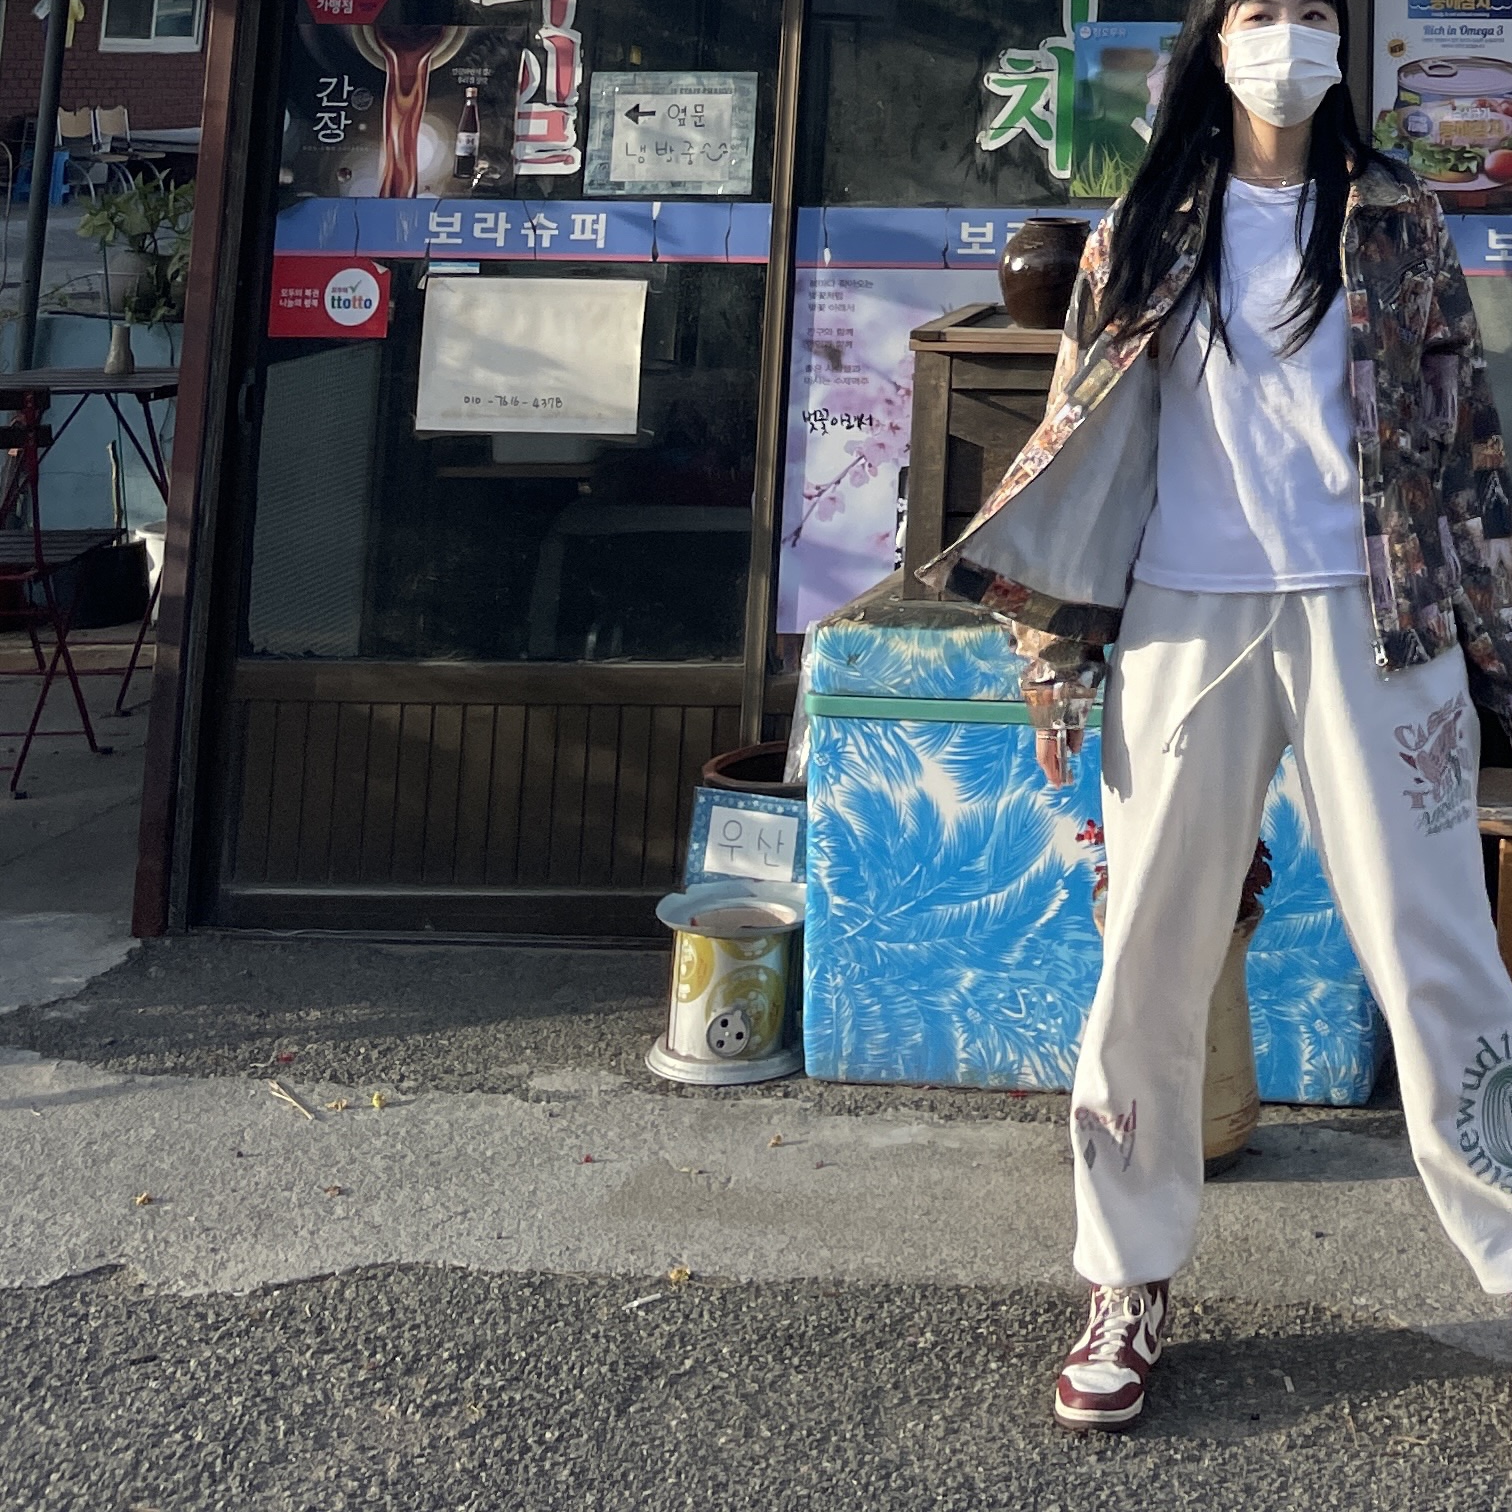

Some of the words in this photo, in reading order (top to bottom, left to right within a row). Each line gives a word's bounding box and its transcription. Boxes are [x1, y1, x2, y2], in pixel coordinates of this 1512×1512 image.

[1423, 25, 1444, 36] Rich
[1447, 25, 1457, 35] in
[1459, 25, 1495, 38] Omega
[1496, 25, 1504, 36] 3
[312, 74, 355, 144] 간장
[667, 103, 706, 128] 옆문
[424, 212, 608, 249] 보라슈퍼
[331, 295, 373, 309] ttotto
[717, 819, 785, 867] 우산
